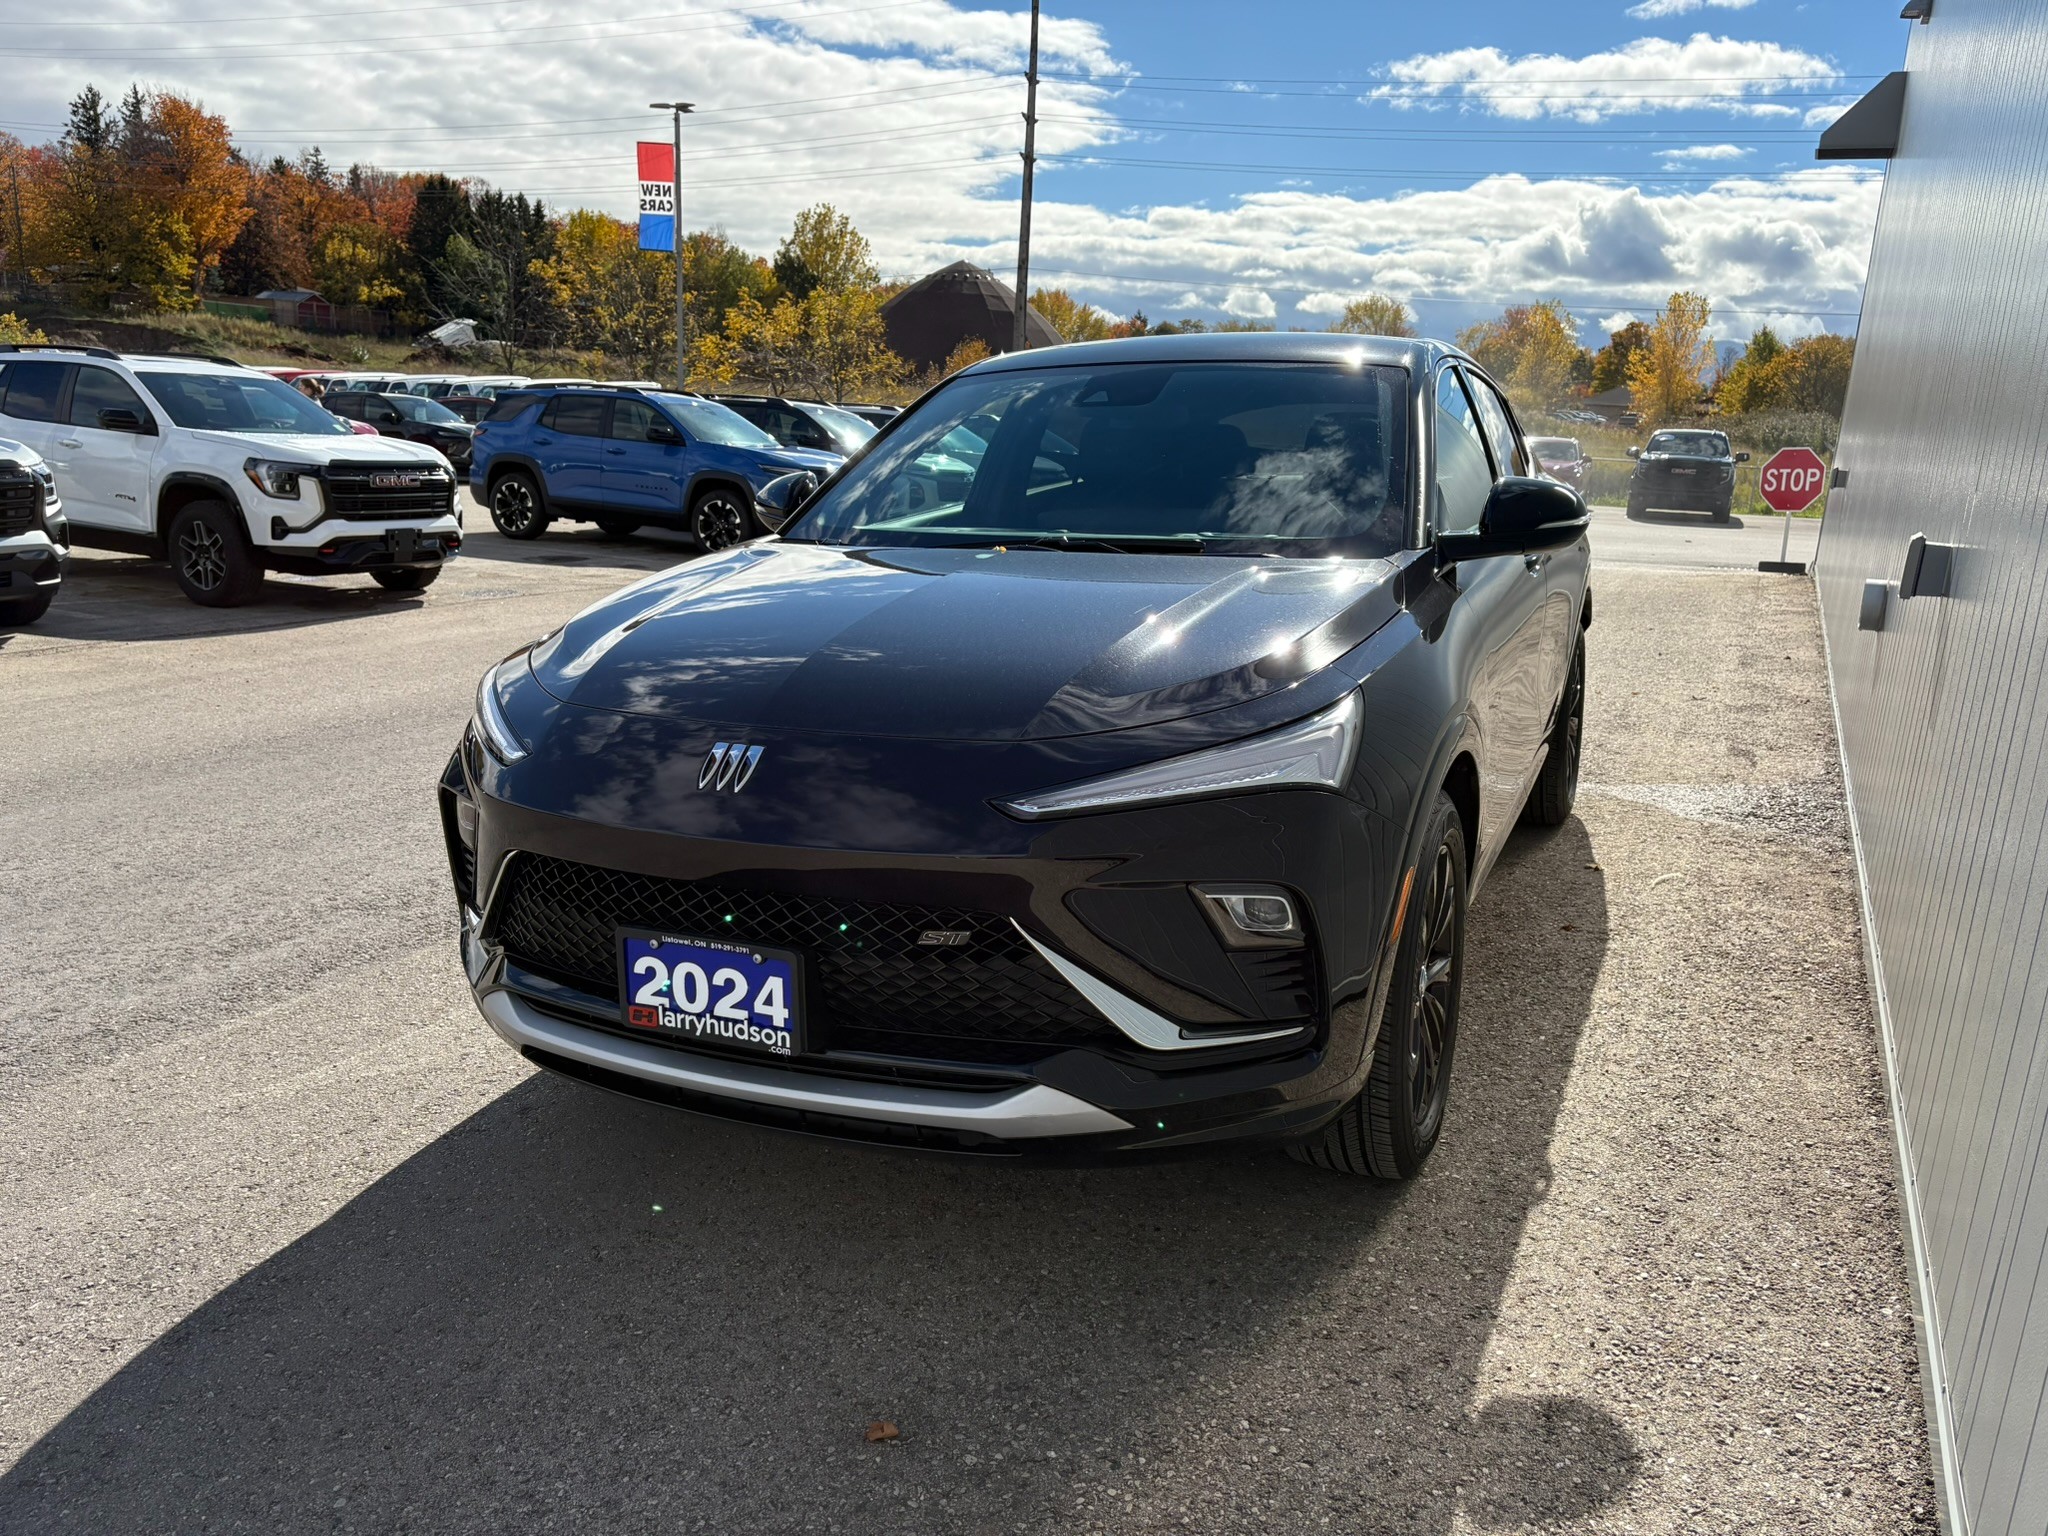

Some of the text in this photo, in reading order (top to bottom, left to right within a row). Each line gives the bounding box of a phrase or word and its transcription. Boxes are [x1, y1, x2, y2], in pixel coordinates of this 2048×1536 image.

[376, 475, 420, 486] GMC
[1764, 468, 1820, 492] STOP
[661, 935, 694, 946] Listowel,
[694, 940, 707, 948] ON
[633, 956, 789, 1028] 2024
[658, 1005, 791, 1048] larryhudson
[768, 1045, 791, 1056] .com
